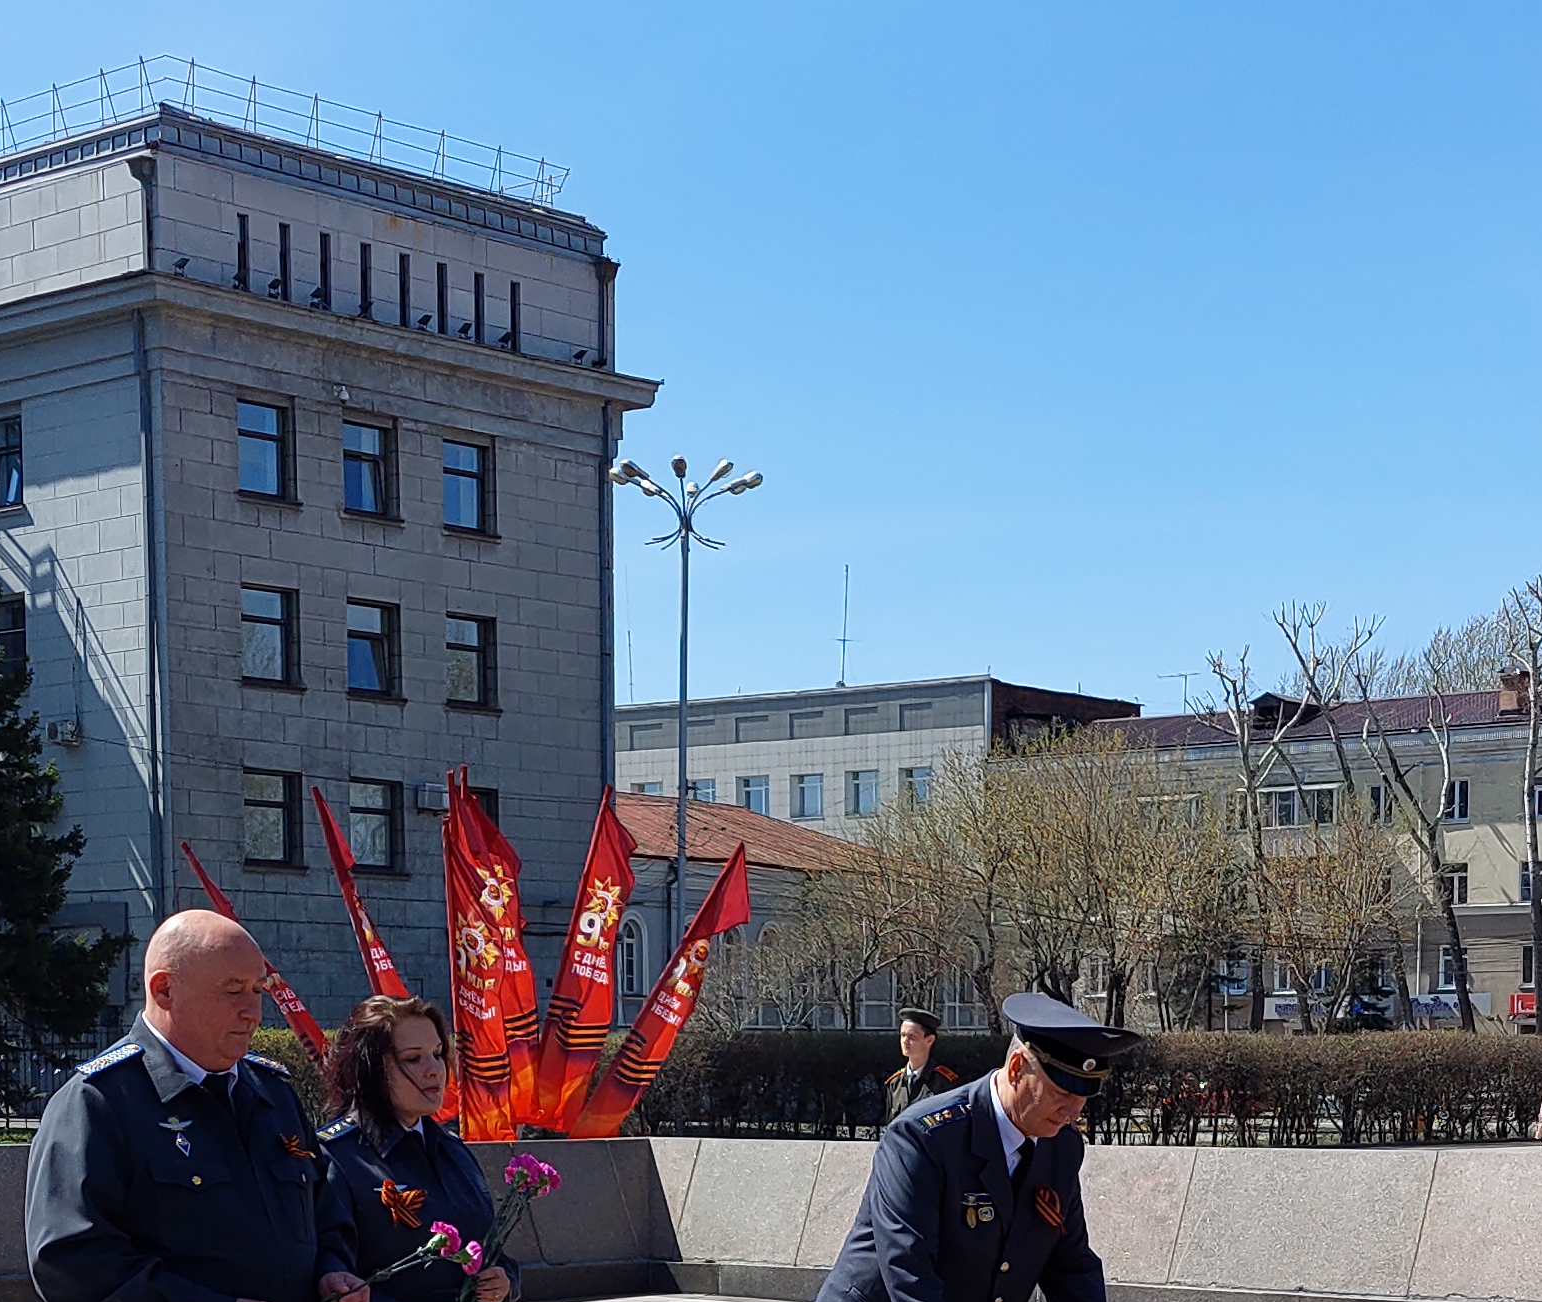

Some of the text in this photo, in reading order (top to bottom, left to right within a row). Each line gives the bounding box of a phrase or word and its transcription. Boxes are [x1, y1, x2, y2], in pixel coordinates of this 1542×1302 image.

[576, 911, 601, 948] 9
[574, 950, 581, 961] С
[571, 963, 610, 985] ПОБЕД
